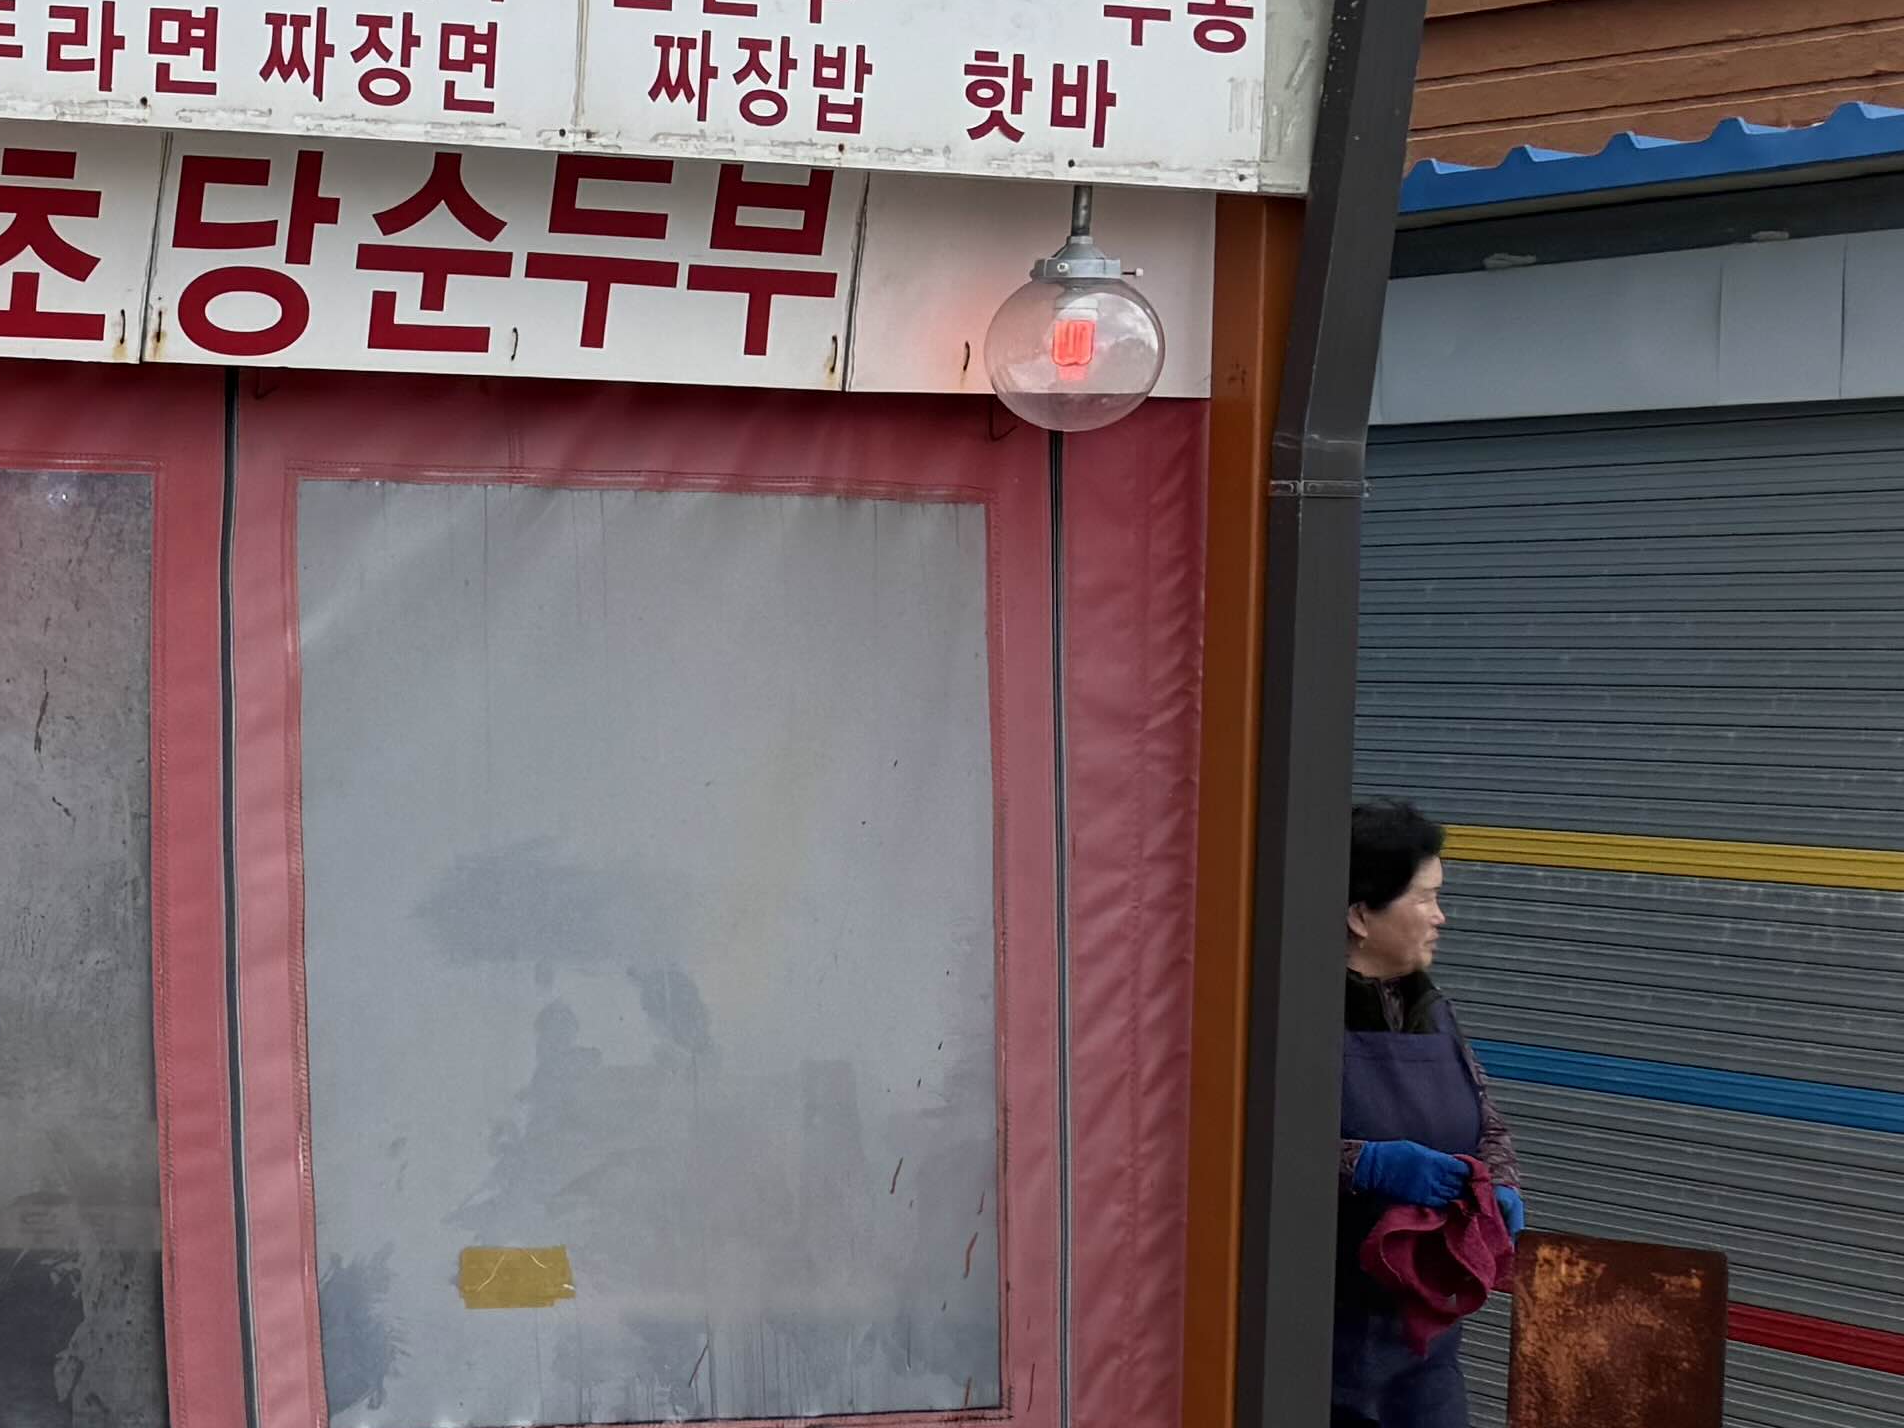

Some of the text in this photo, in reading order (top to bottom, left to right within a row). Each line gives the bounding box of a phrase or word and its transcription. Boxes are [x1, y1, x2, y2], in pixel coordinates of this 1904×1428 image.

[259, 7, 499, 114] 짜장면
[649, 34, 1116, 147] 짜장밥 핫바
